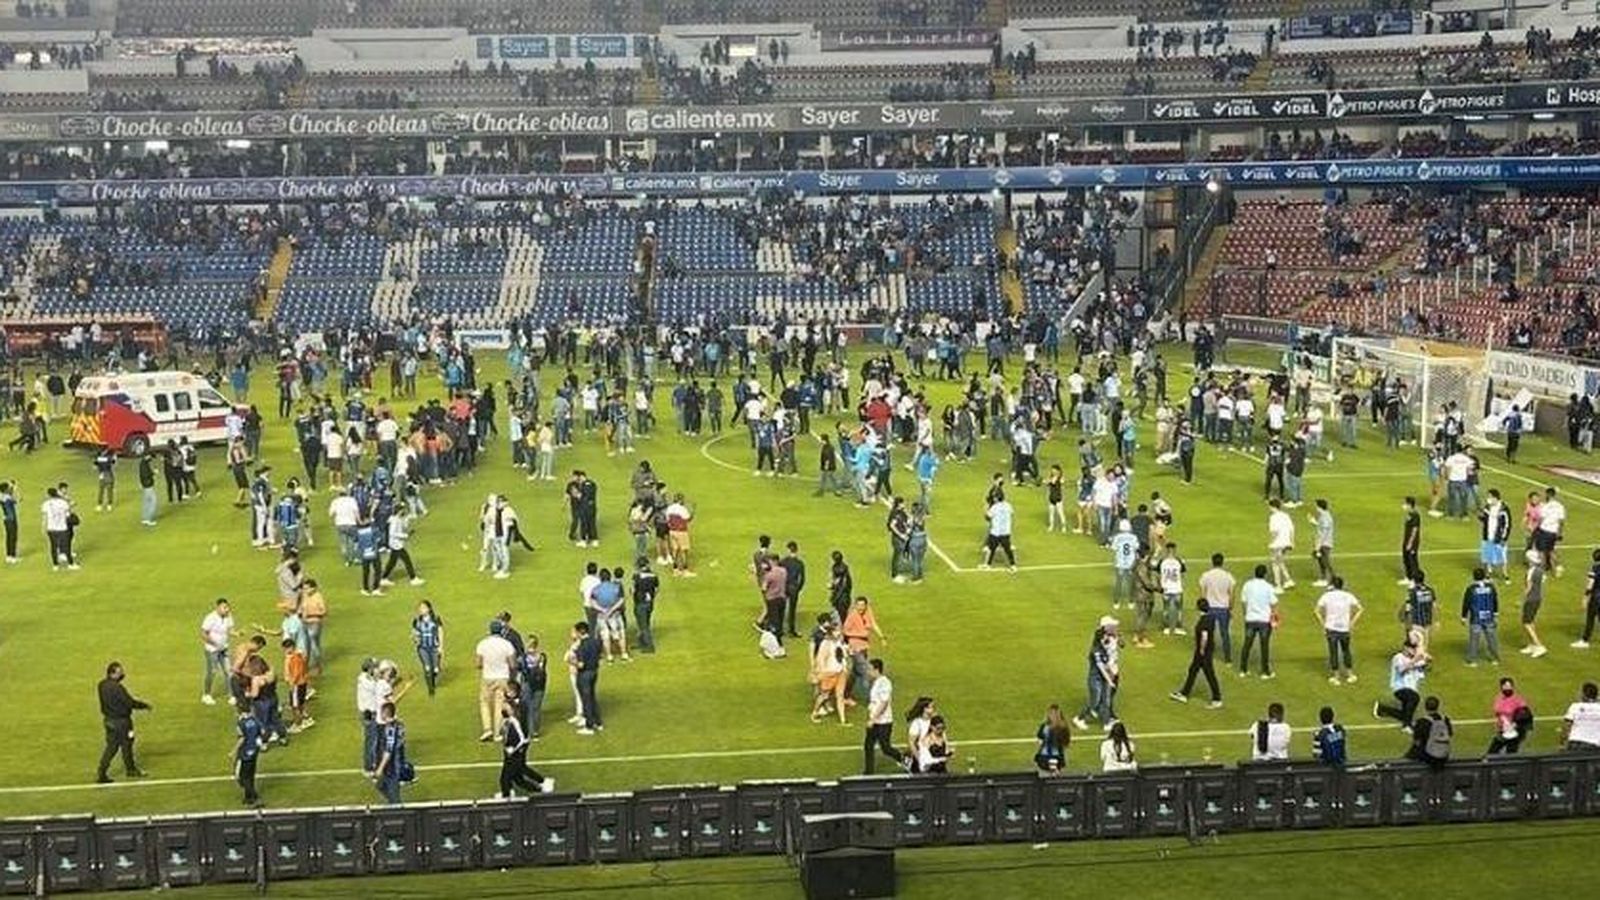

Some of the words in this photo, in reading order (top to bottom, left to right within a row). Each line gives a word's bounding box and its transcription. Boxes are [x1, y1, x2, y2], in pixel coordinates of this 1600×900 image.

[502, 38, 545, 56] Sayer
[581, 37, 622, 55] Sayer
[650, 108, 775, 130] caliente.mx
[801, 107, 860, 129] Sayer
[881, 105, 940, 127] Sayer
[625, 176, 697, 189] caliente.mx
[818, 172, 862, 187] Sayer
[896, 171, 939, 187] Sayer
[1123, 543, 1130, 556] 8
